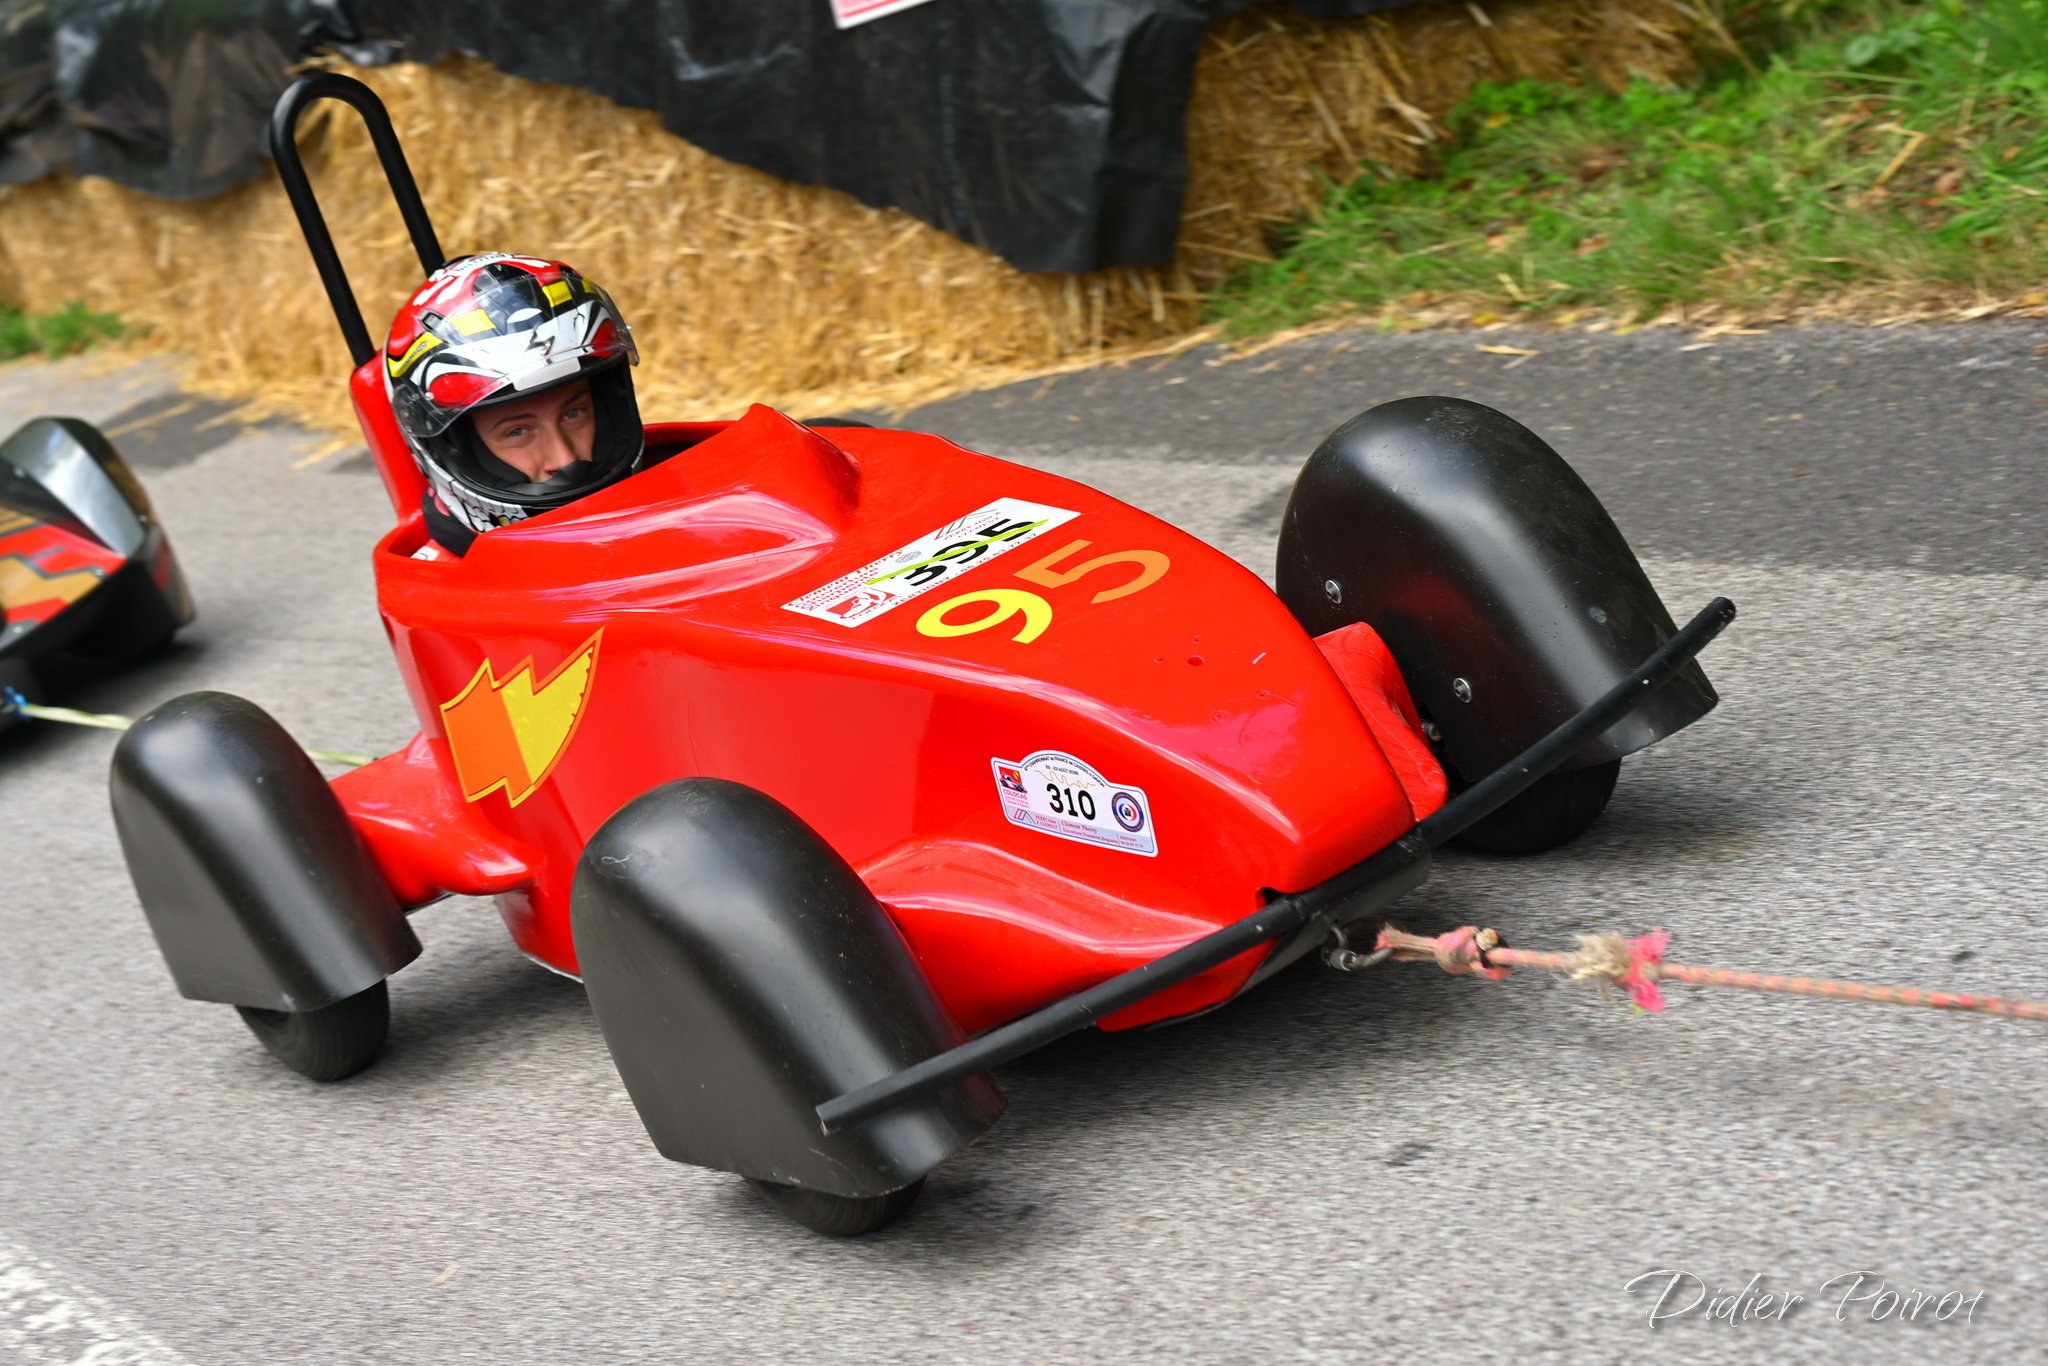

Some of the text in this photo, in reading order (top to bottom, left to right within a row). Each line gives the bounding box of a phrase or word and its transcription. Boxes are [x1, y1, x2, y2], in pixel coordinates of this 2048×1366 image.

[890, 518, 1035, 586] 395
[916, 539, 1170, 644] 95
[1003, 789, 1028, 800] COLOCAS
[1046, 783, 1096, 821] 310
